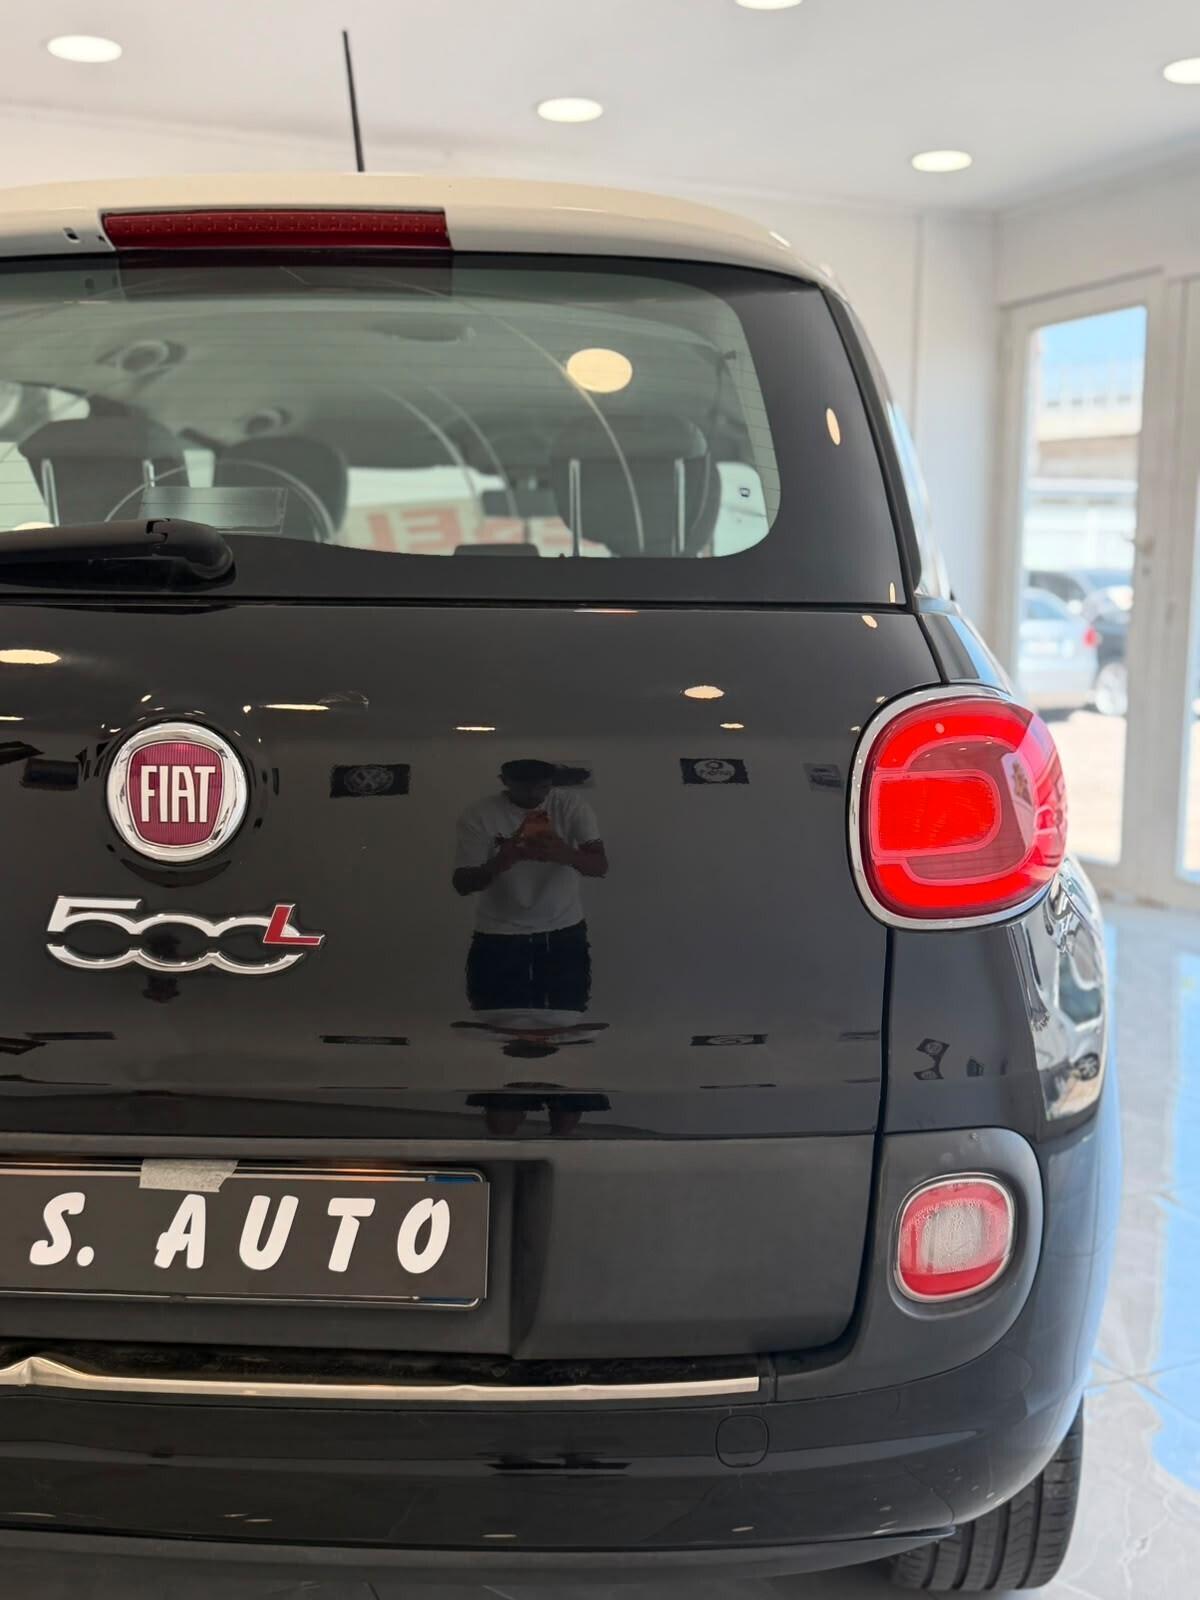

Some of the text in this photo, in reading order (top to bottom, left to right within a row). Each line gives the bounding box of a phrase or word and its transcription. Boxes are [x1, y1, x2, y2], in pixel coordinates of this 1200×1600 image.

[140, 765, 217, 824] FIAT
[46, 895, 325, 975] 500L
[29, 1191, 451, 1274] S. AUTO
